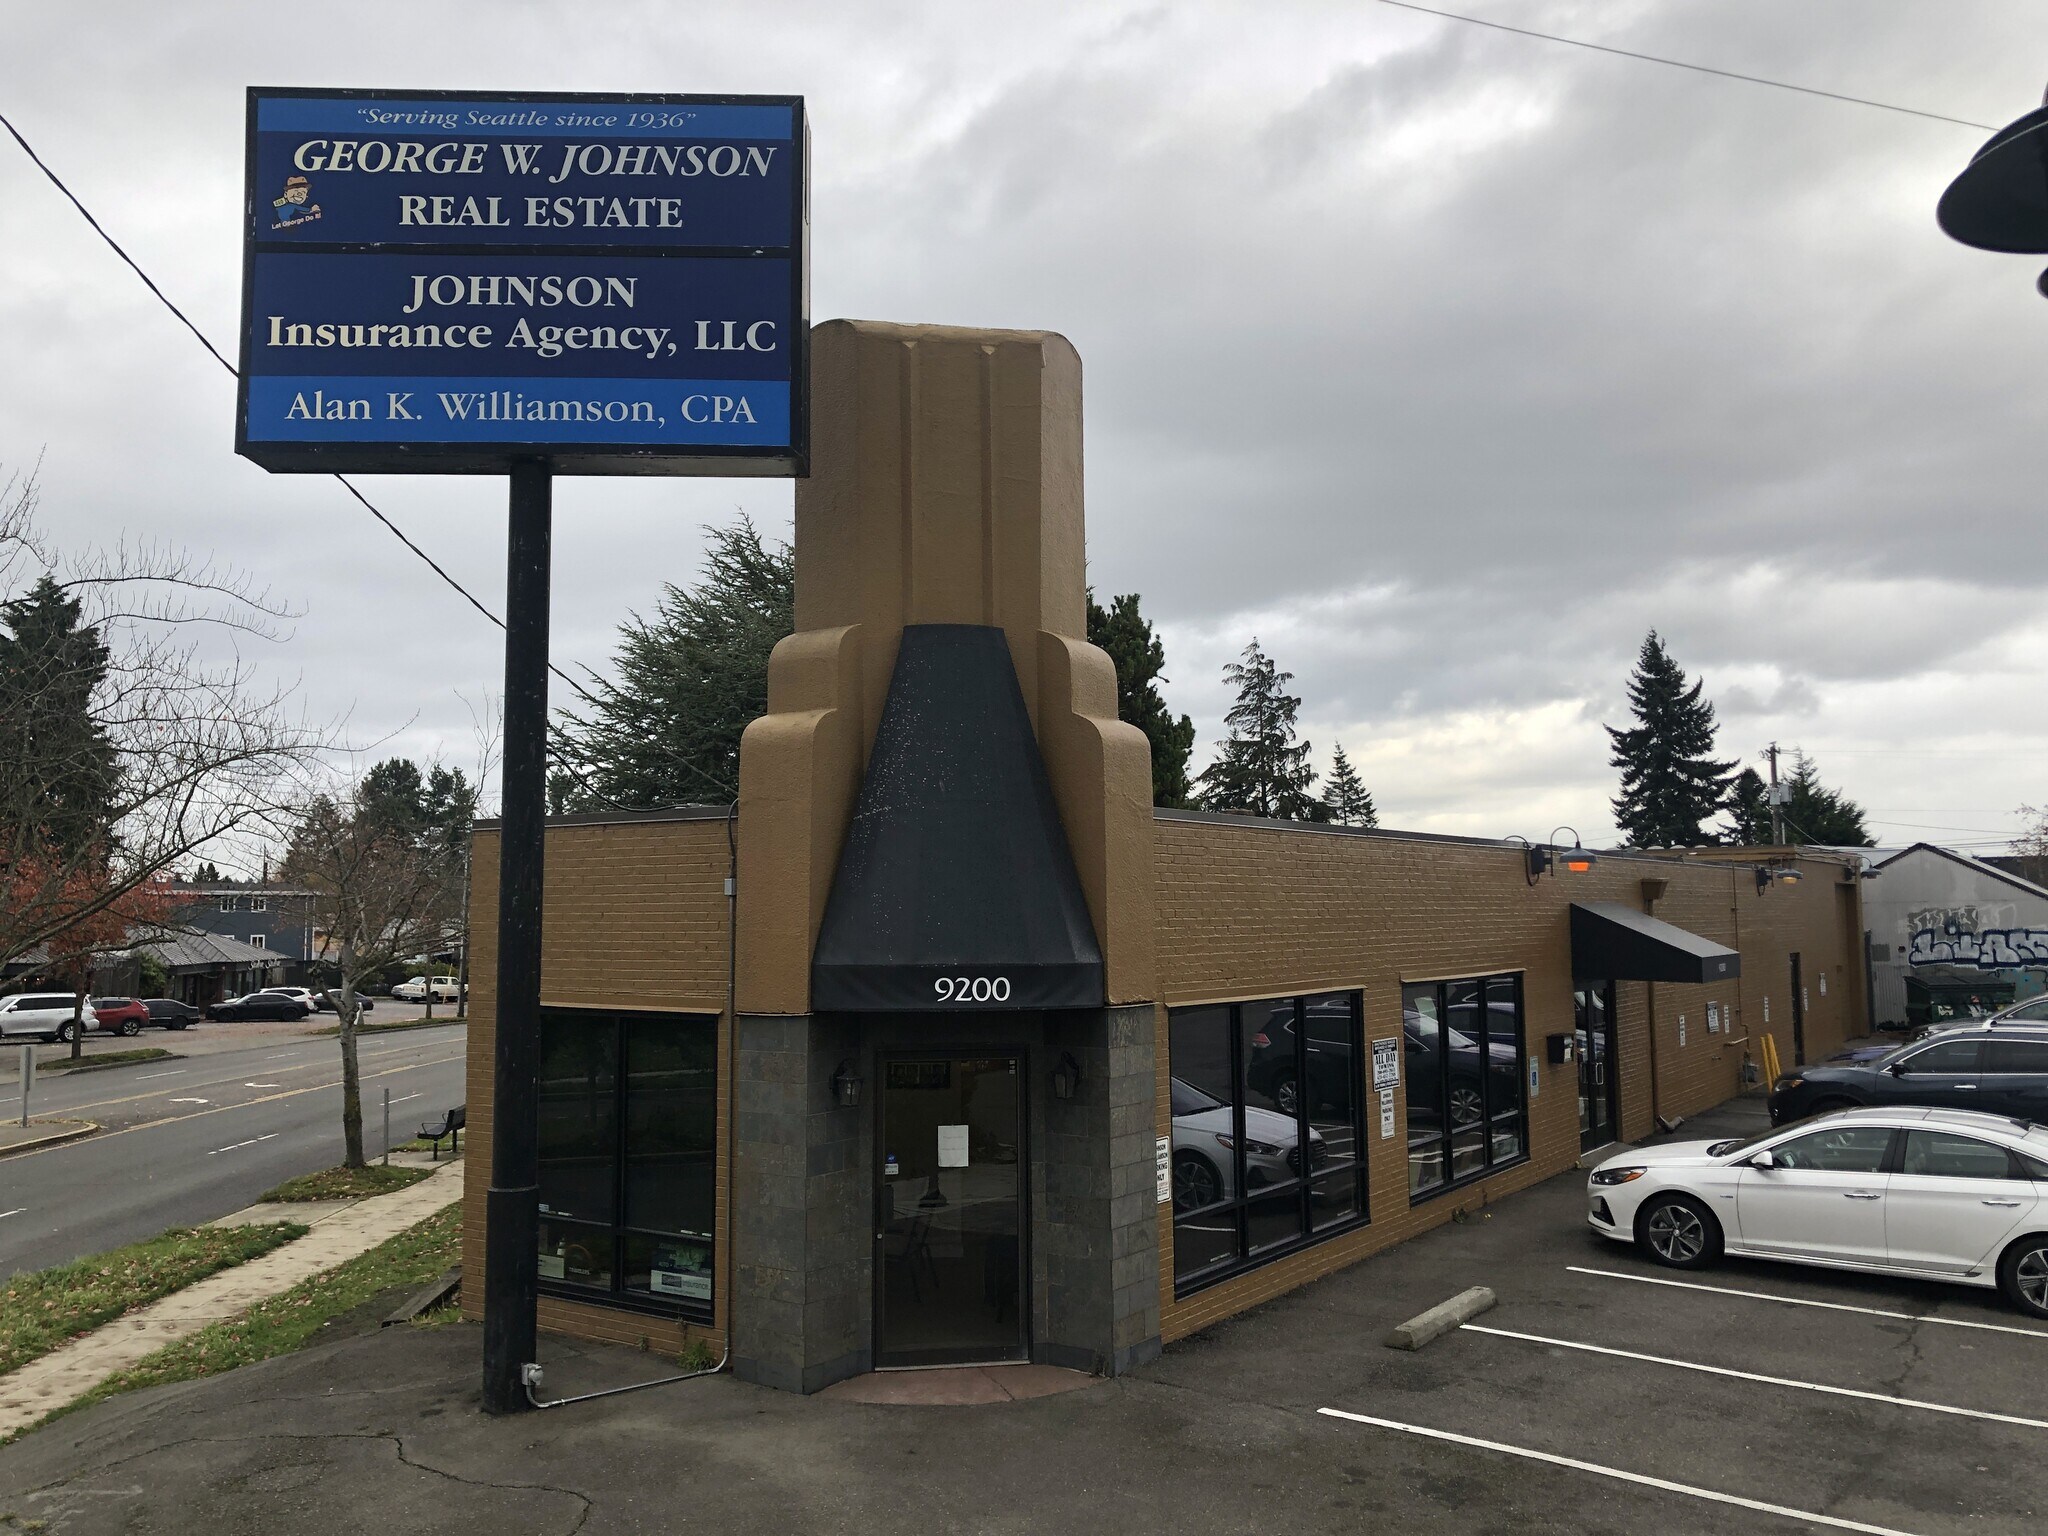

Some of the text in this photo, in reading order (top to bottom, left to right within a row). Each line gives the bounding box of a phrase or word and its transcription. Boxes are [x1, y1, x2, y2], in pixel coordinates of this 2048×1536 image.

[465, 110, 549, 127] Seattle
[554, 112, 618, 128] since
[293, 140, 777, 184] GEORGE W. JOHNSON
[399, 195, 683, 228] REAL ESTATE
[403, 275, 638, 314] JOHNSON
[267, 315, 777, 359] Insurance Agency, LLC
[285, 391, 758, 430] Alan K. Williamson, CPA
[934, 976, 1011, 1002] 9200
